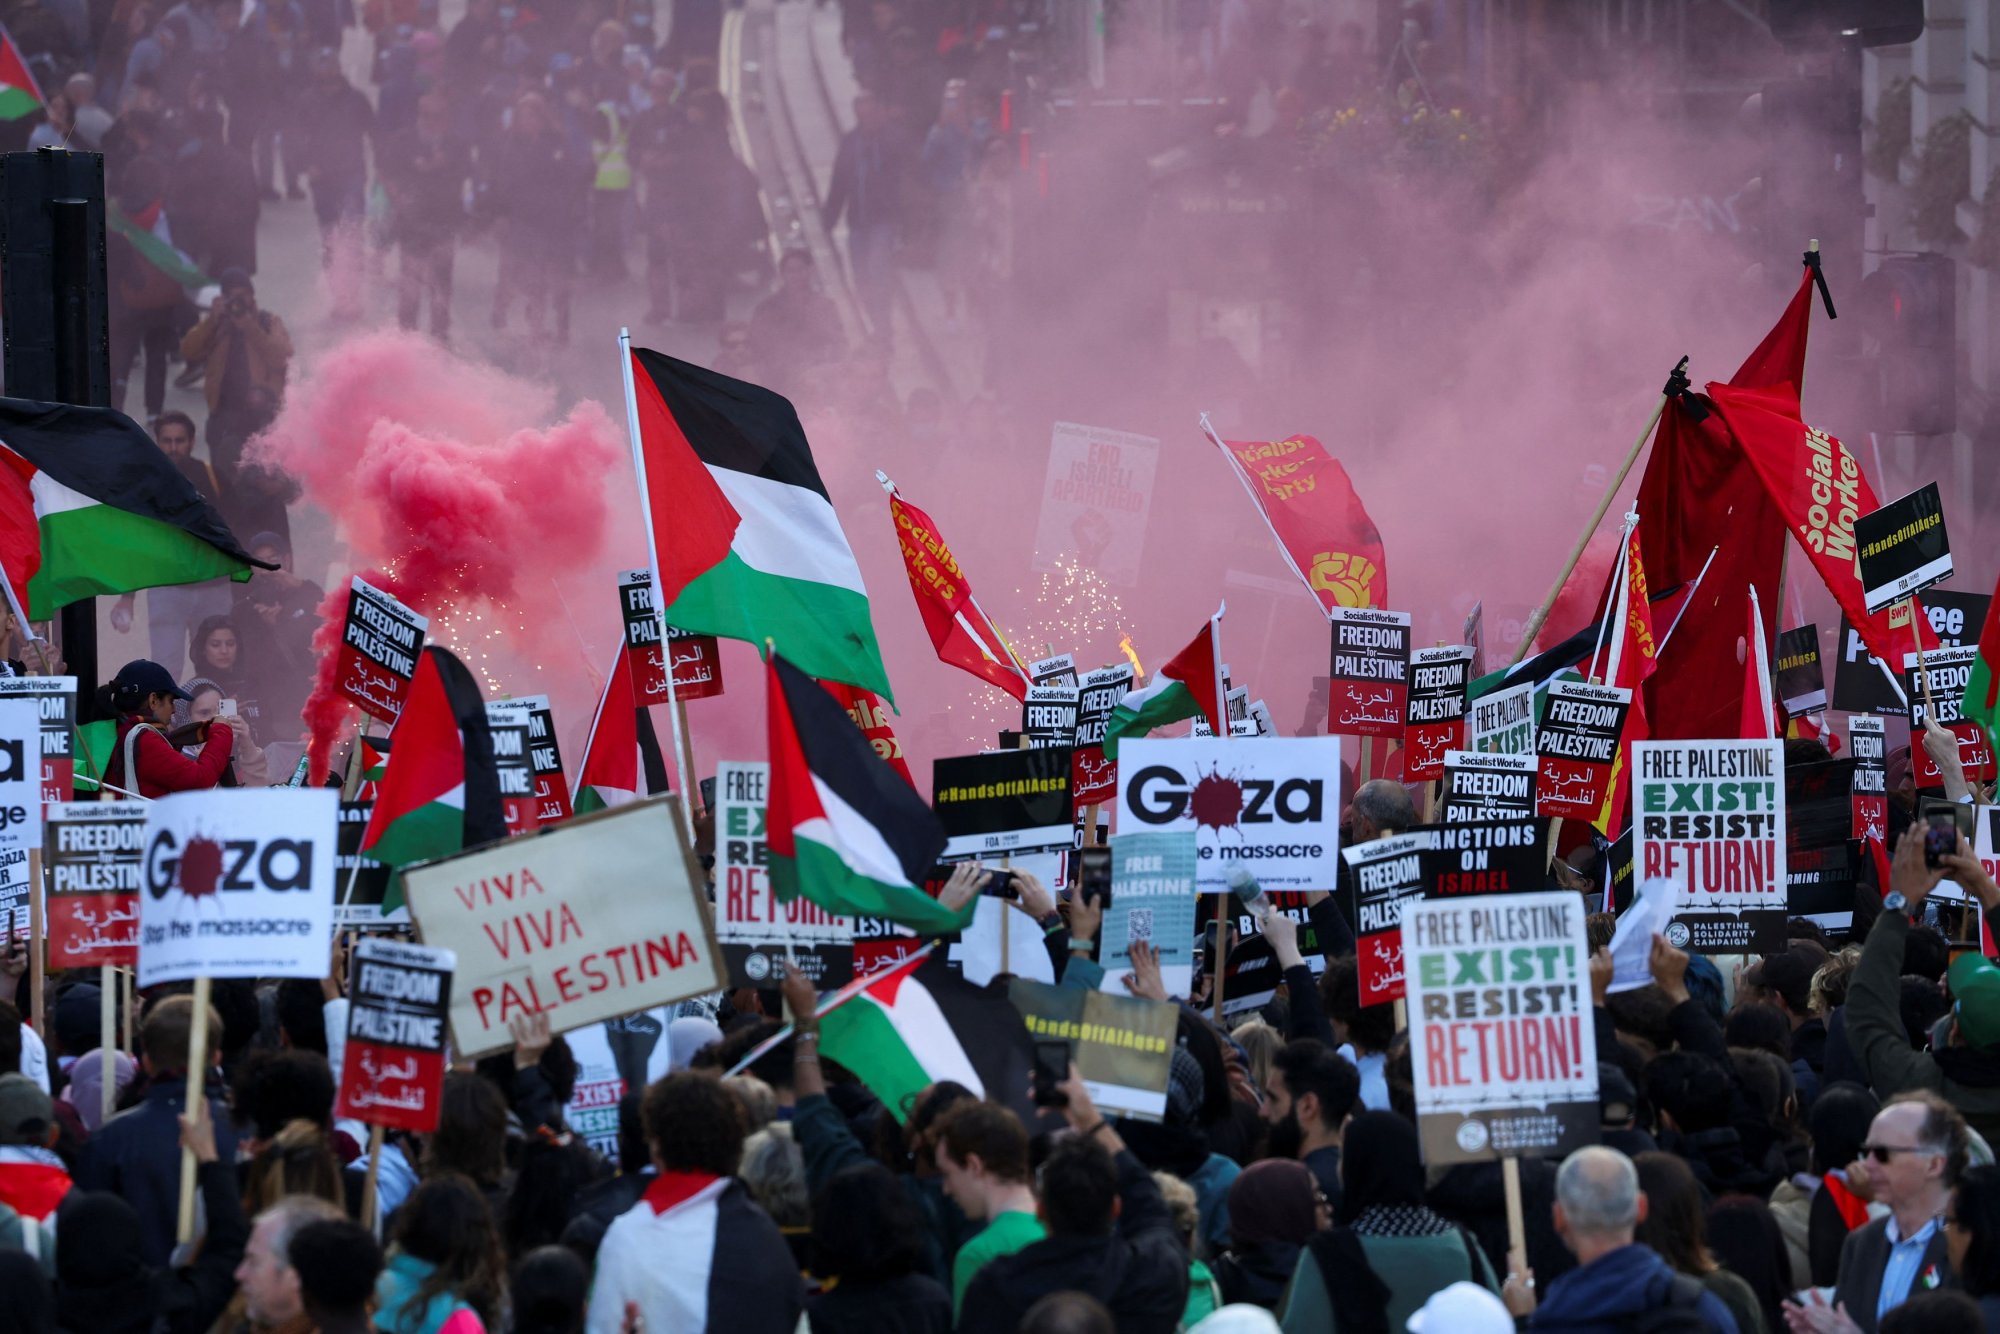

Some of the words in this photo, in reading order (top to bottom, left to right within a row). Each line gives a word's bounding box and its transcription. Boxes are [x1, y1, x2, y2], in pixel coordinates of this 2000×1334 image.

[1088, 443, 1121, 467] END
[1070, 460, 1134, 490] ISRAELI
[1800, 426, 1832, 553] Socialis
[1861, 511, 1941, 560] #HandsOffAlAqsa
[362, 586, 392, 609] Socialist
[390, 603, 416, 624] Worker
[1343, 611, 1375, 622] Socialist
[1375, 612, 1400, 624] Worker
[1891, 605, 1908, 620] SWP
[354, 597, 416, 649] FREEDOM
[376, 631, 388, 644] for
[1339, 625, 1402, 650] FREEDOM
[346, 622, 414, 679] PALESTINE
[1366, 647, 1377, 657] for
[1420, 652, 1446, 662] Socialist
[1446, 650, 1462, 659] Worker
[354, 656, 397, 693] الحرية
[1087, 674, 1112, 686] Socialist
[1112, 669, 1127, 681] Worker
[1335, 655, 1405, 680] PALESTINE
[1414, 664, 1463, 689] FREEDOM
[1032, 690, 1058, 699] Socialist
[1058, 690, 1075, 699] Worker
[1346, 685, 1393, 705] الحرية
[1436, 687, 1445, 697] for
[1561, 685, 1594, 698] Socialist
[1594, 688, 1620, 700] Worker
[1944, 689, 1956, 699] for
[1028, 706, 1076, 728] FREEDOM
[1101, 710, 1111, 720] for
[1339, 706, 1399, 724] لفلسطين
[1409, 695, 1464, 721] PALESTINE
[1476, 701, 1497, 734] FREE
[1497, 690, 1530, 728] PALESTINE
[1550, 700, 1619, 727] FREEDOM
[1053, 728, 1063, 738] for
[1075, 721, 1109, 747] PALES
[1575, 724, 1588, 735] for
[1854, 720, 1869, 729] Socialist
[1869, 722, 1880, 730] Worker
[1417, 727, 1453, 749] الحرية
[1537, 731, 1615, 760] PALESTINE
[1853, 737, 1883, 758] FREEDOM
[1459, 756, 1497, 767] Socialist
[1497, 758, 1526, 769] Worker
[1543, 762, 1593, 785] الحرية
[1643, 750, 1682, 778] FREE
[1689, 748, 1773, 778] PALESTINE
[727, 770, 764, 801] FREE
[938, 777, 1066, 803] #HandsOffAlAqsa
[1452, 772, 1529, 798] FREEDOM
[1854, 770, 1885, 792] PALESTINE
[1126, 764, 1323, 825] Gza
[1484, 796, 1498, 807] for
[1643, 782, 1774, 812] EXIST!
[1860, 802, 1881, 822] الحرية
[58, 823, 147, 852] FREEDOM
[1429, 825, 1535, 850] ANCTIONS
[1644, 814, 1774, 839] RESIST!
[1220, 844, 1323, 860] massacre
[1360, 844, 1391, 859] Socialist
[1391, 839, 1416, 851] Worker
[1461, 850, 1488, 871] ON
[148, 829, 313, 900] Gza
[1125, 855, 1163, 873] FREE
[1359, 855, 1420, 893] FREEDOM
[1644, 840, 1775, 893] RETURN!
[53, 864, 142, 891] PALESTIN
[454, 867, 544, 911] VIVA
[1437, 871, 1510, 894] ISRAEL
[1787, 871, 1820, 884] RMING
[198, 918, 311, 938] massacre
[483, 902, 584, 959] VIVA
[1415, 911, 1463, 946] FREE
[1471, 904, 1573, 943] PALESTINE
[1694, 922, 1750, 930] PALESTINE
[1694, 930, 1756, 938] SOLIDARITY
[1694, 938, 1748, 946] CAMPAIGN
[1418, 946, 1577, 988] EXIST!
[358, 963, 441, 1003] FREEDOM
[472, 931, 699, 1031] PALESTINA
[1421, 984, 1578, 1020] RESIST!
[350, 1005, 443, 1048] PALESTINE
[1025, 1014, 1166, 1053] HandsOffAlAqsa
[1425, 1016, 1583, 1088] RETURN!
